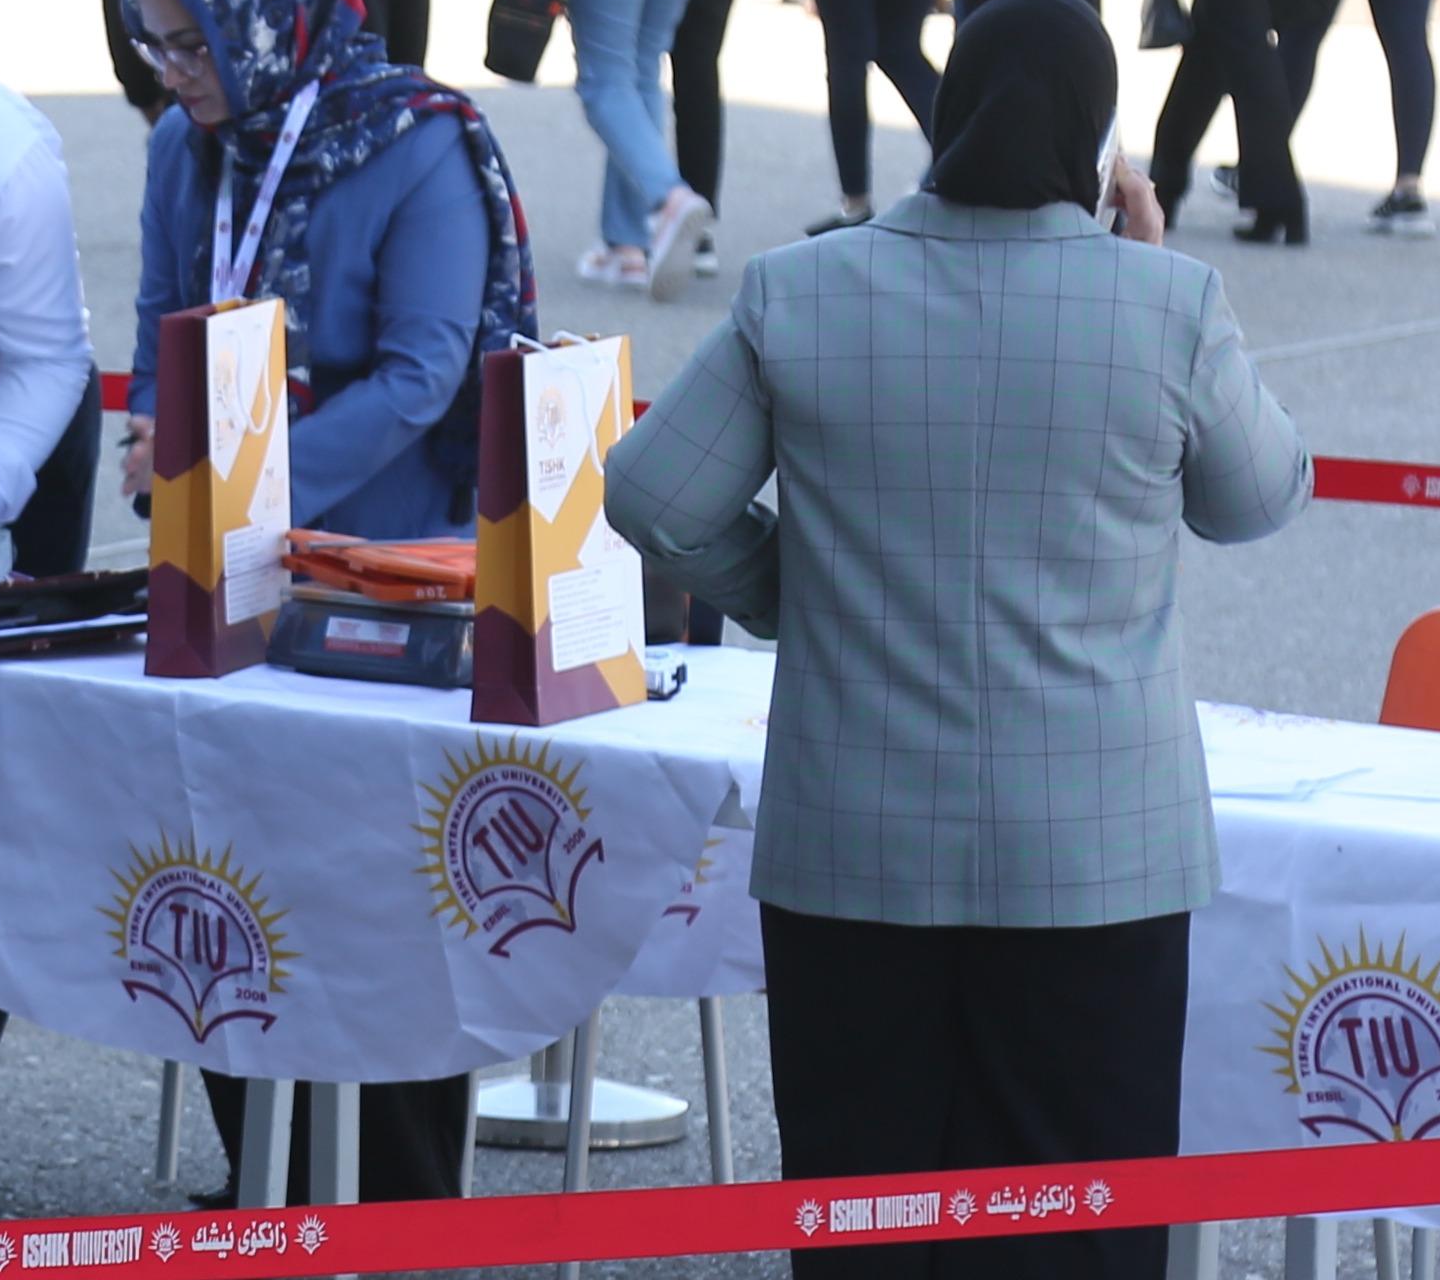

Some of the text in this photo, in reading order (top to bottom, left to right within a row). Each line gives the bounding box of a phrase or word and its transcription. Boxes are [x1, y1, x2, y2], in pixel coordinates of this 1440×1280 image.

[502, 770, 569, 813] UNIVERSITY
[472, 797, 545, 879] TIU
[169, 902, 227, 971] TIU
[227, 894, 267, 973] UNIVERSITY
[1338, 1017, 1420, 1079] TIU
[829, 1192, 941, 1233] ISHIK UNIVERSITY
[22, 1226, 142, 1269] ISHIK UNIVERSITY
